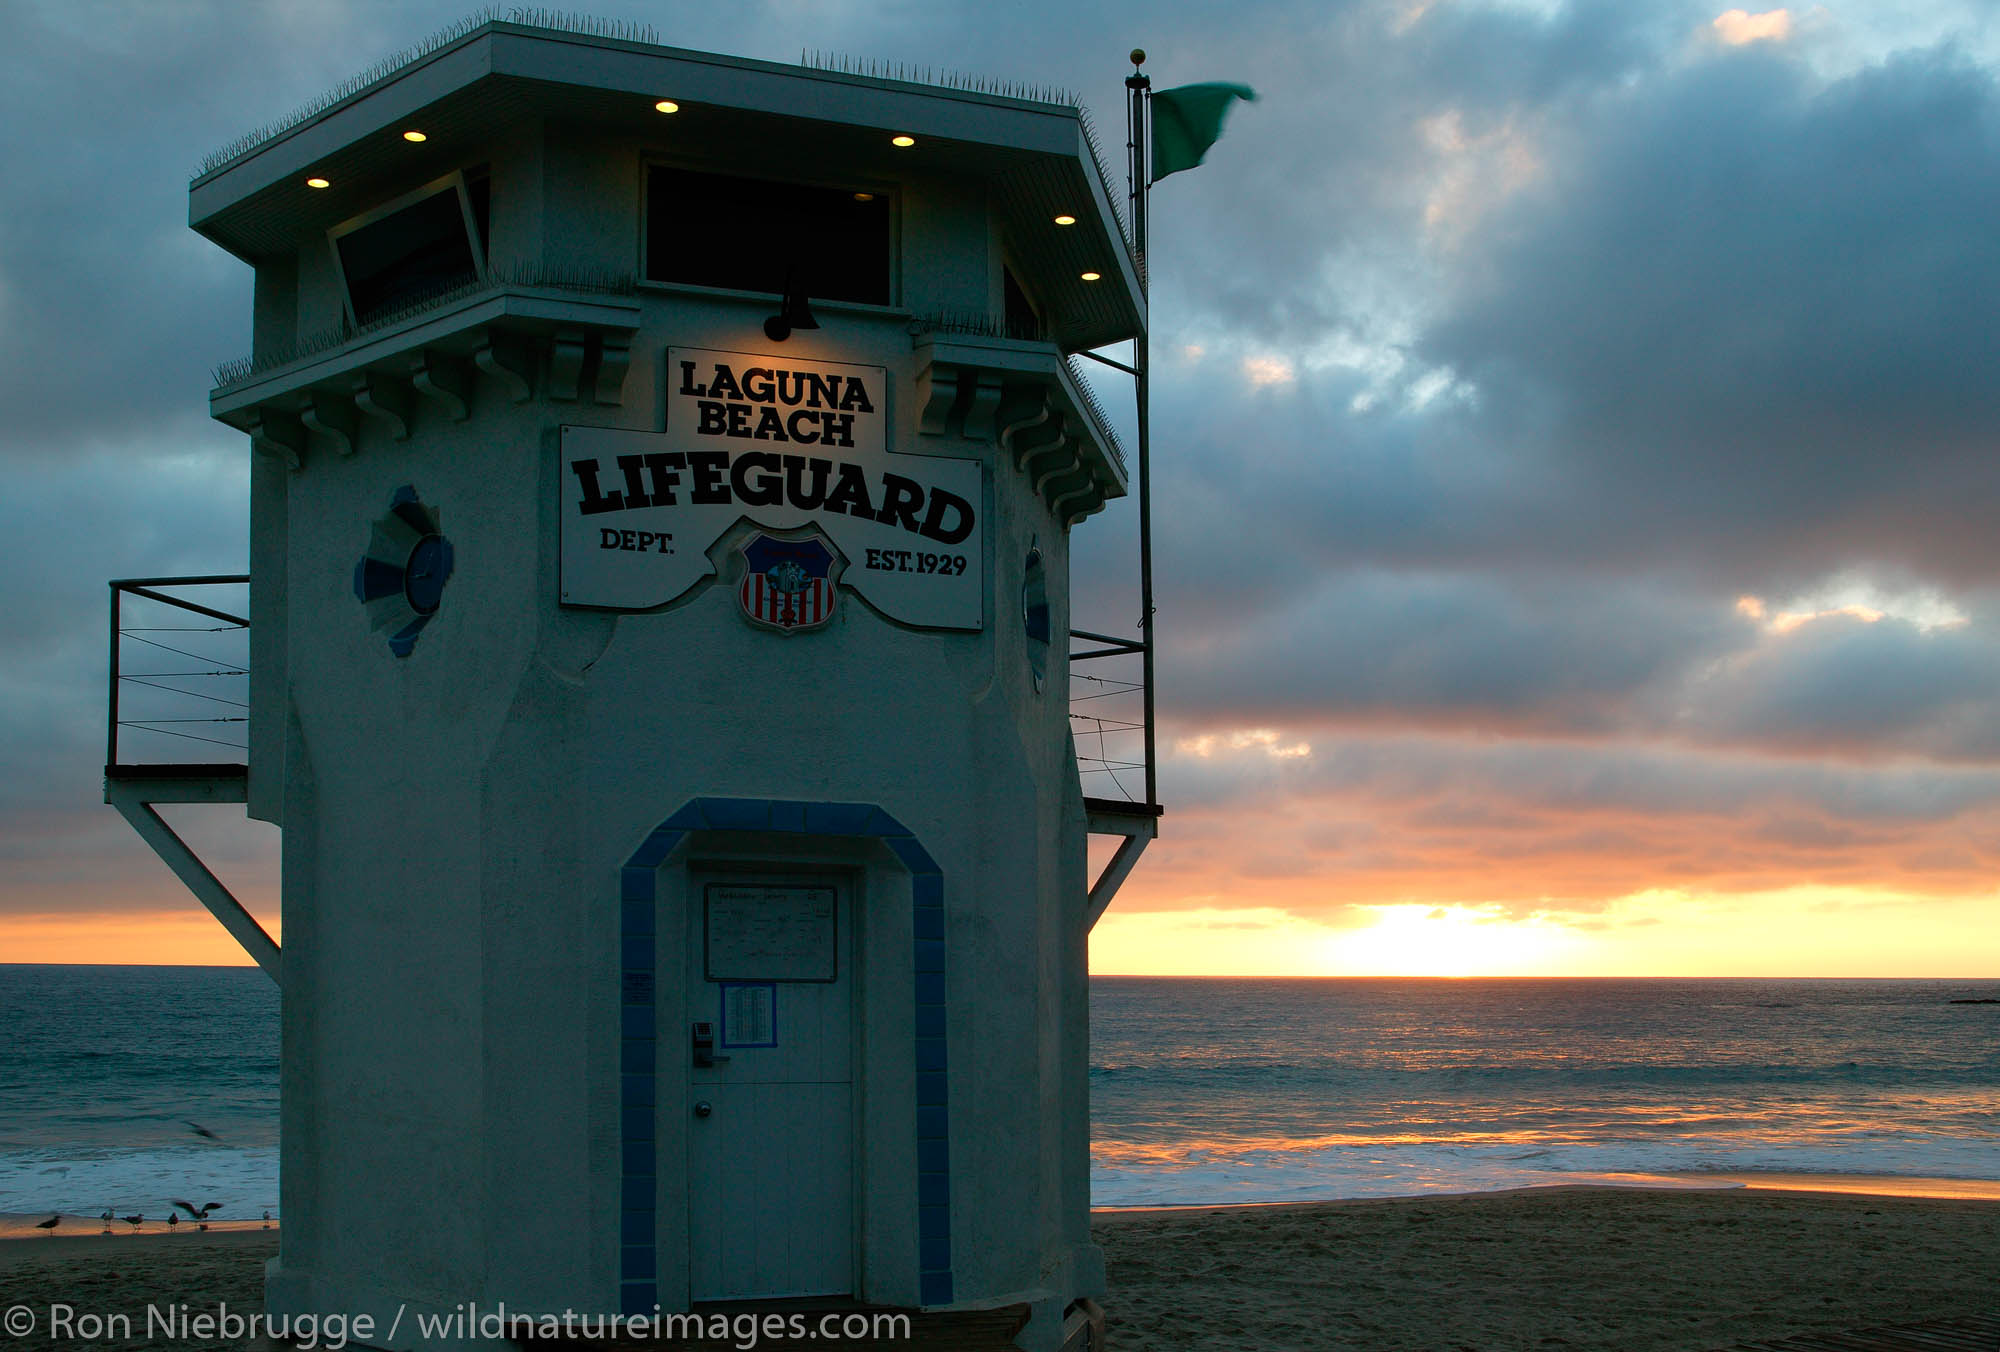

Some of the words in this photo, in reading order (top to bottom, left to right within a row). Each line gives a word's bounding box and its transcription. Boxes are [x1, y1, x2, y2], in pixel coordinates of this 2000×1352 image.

[679, 360, 875, 413] LAGUNA
[697, 400, 855, 448] BEACH
[571, 451, 976, 545] LIFEGUARD
[600, 528, 675, 555] DEPT.
